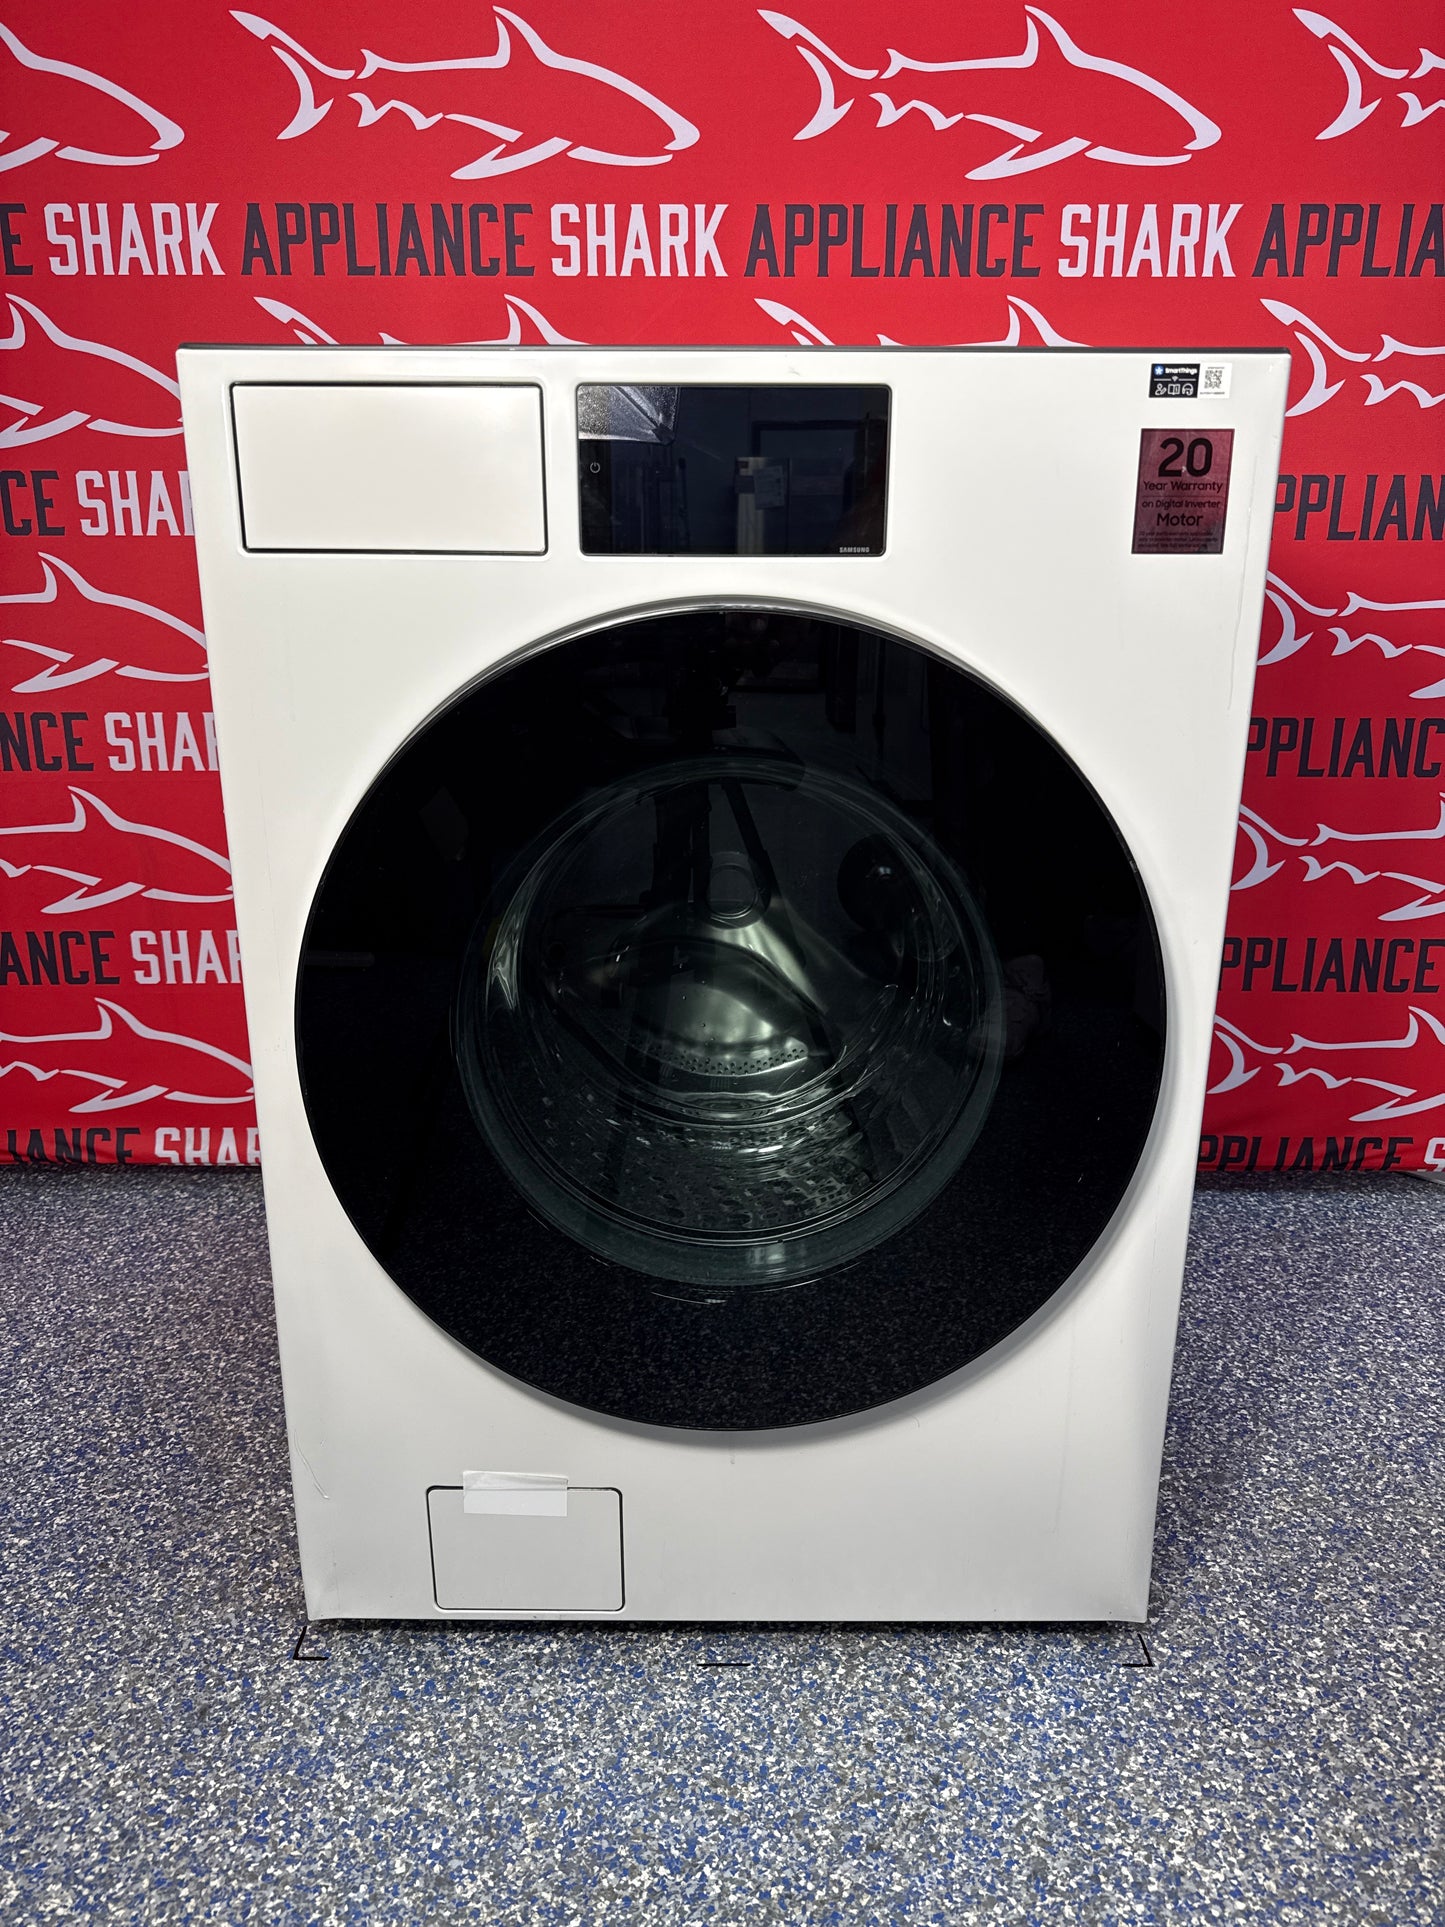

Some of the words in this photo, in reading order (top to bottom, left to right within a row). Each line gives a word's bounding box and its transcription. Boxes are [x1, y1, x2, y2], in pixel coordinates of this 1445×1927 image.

[44, 203, 226, 275] SHARK
[241, 203, 535, 275] APPLIANCE
[550, 204, 729, 276] SHARK
[744, 204, 1044, 277] APPLIANCE
[1058, 204, 1243, 277] SHARK
[1158, 437, 1213, 477] 20
[1143, 481, 1168, 491] Year
[1170, 481, 1224, 494] Warranty
[1155, 499, 1183, 510] Digital
[1184, 500, 1221, 508] Inverter
[1156, 513, 1204, 526] Motor
